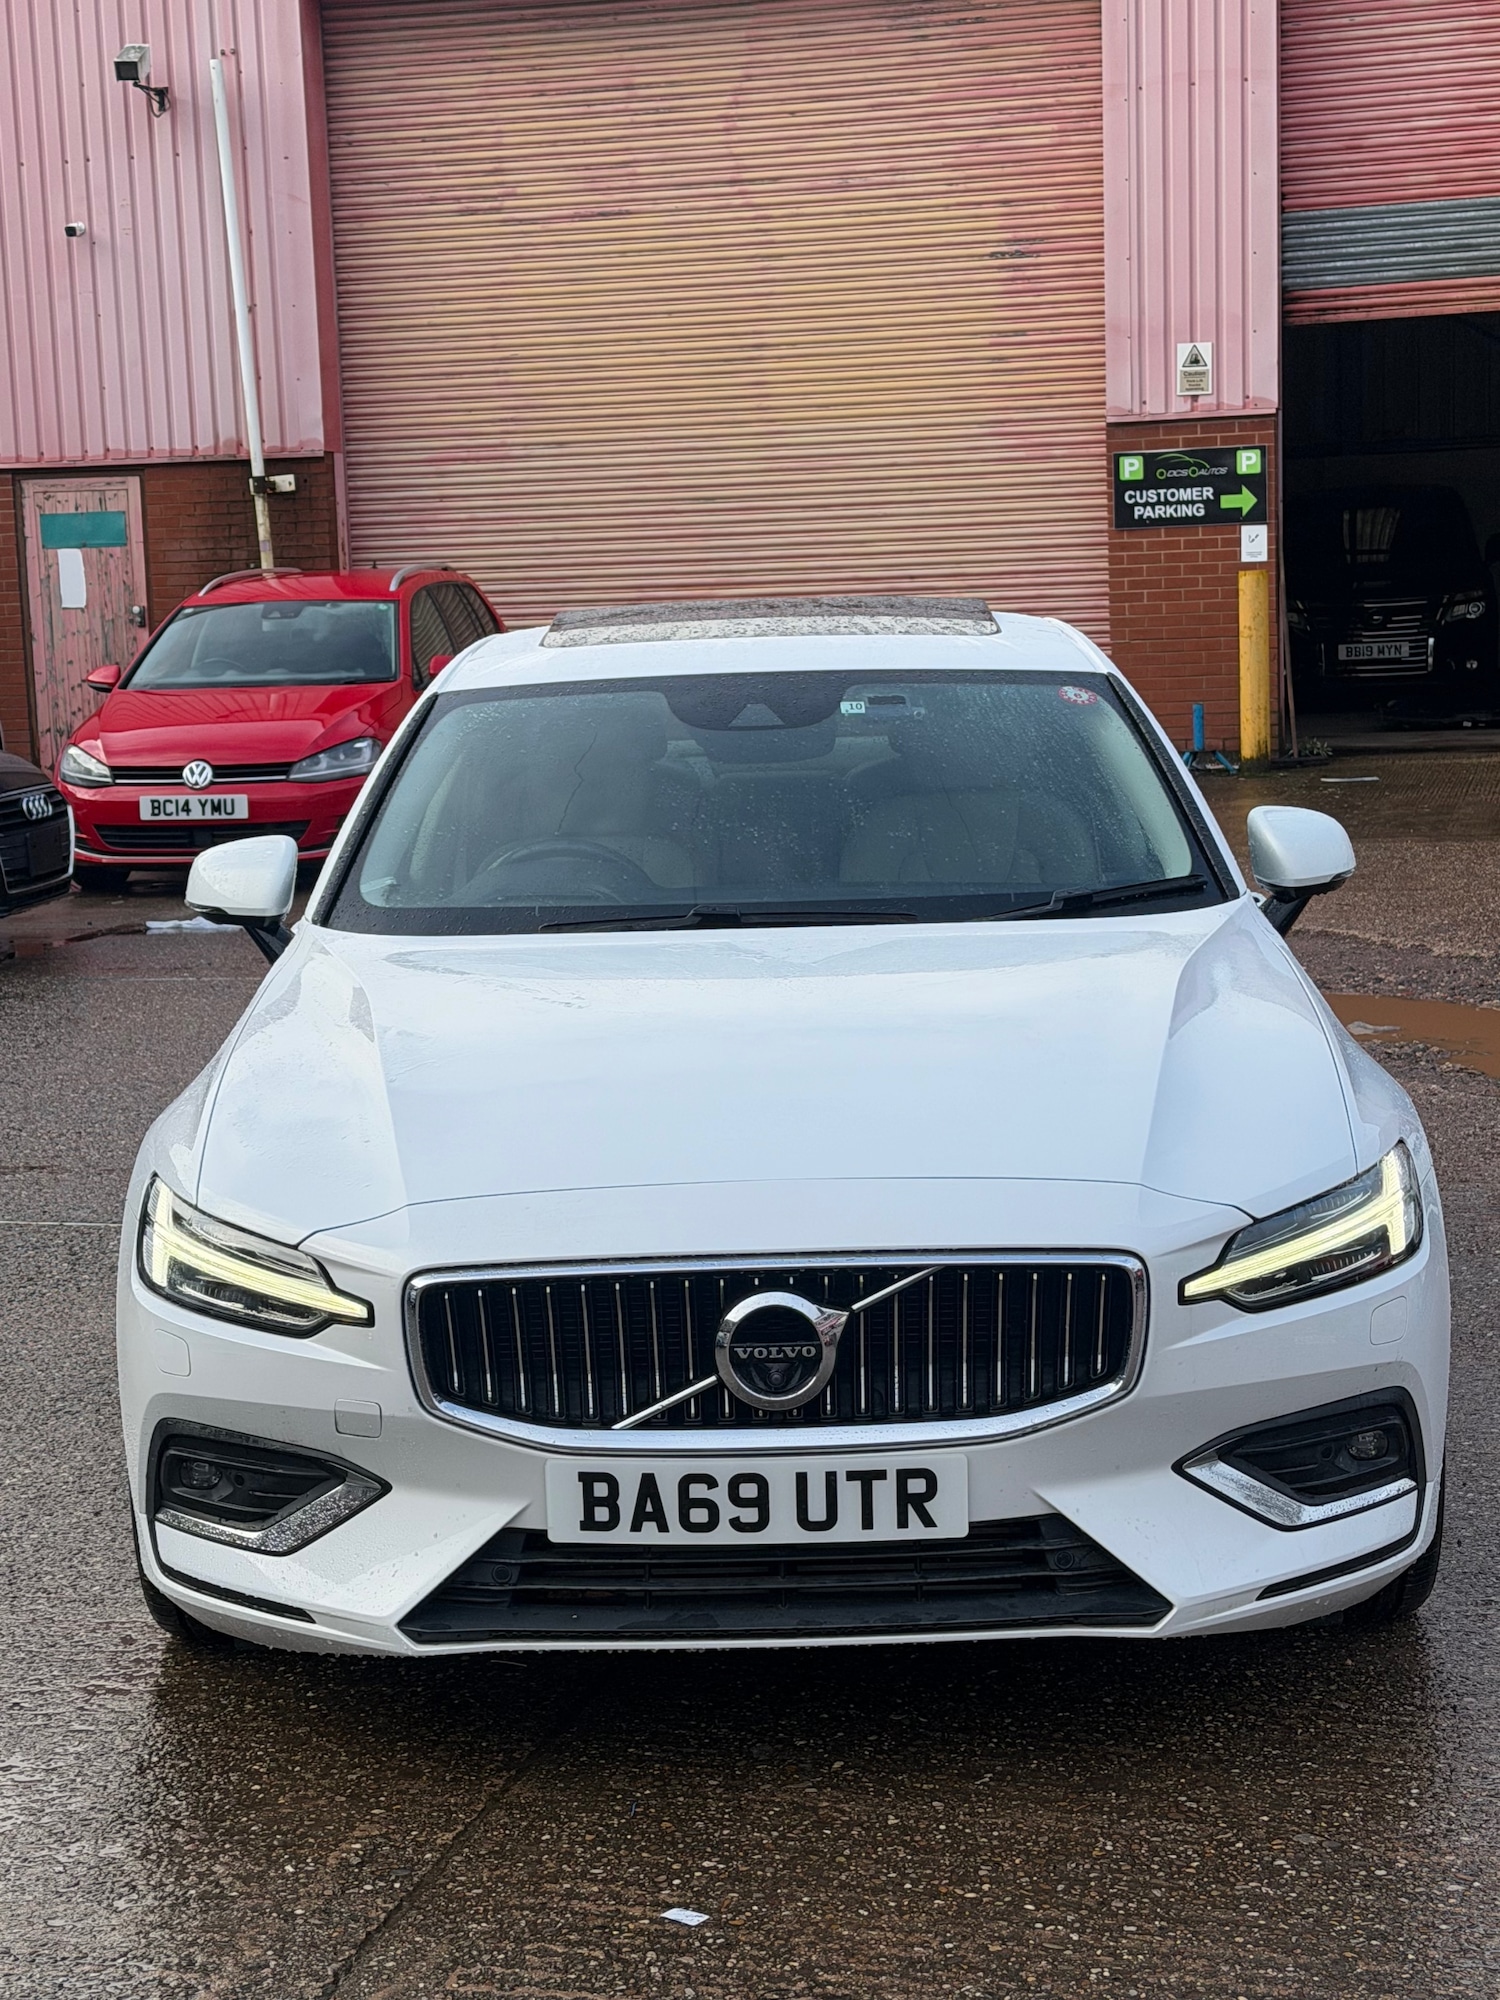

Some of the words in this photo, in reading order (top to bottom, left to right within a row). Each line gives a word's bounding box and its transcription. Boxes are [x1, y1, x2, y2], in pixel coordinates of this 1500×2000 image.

[1124, 458, 1139, 478] P
[1241, 452, 1256, 472] P
[1124, 487, 1214, 504] CUSTOMER
[1134, 504, 1205, 520] PARKING
[1346, 645, 1373, 658] BB19
[150, 799, 192, 816] BC14
[198, 798, 235, 816] YMU
[734, 1346, 816, 1359] VOLVO
[577, 1471, 770, 1533] BA69
[795, 1468, 938, 1532] UTR
